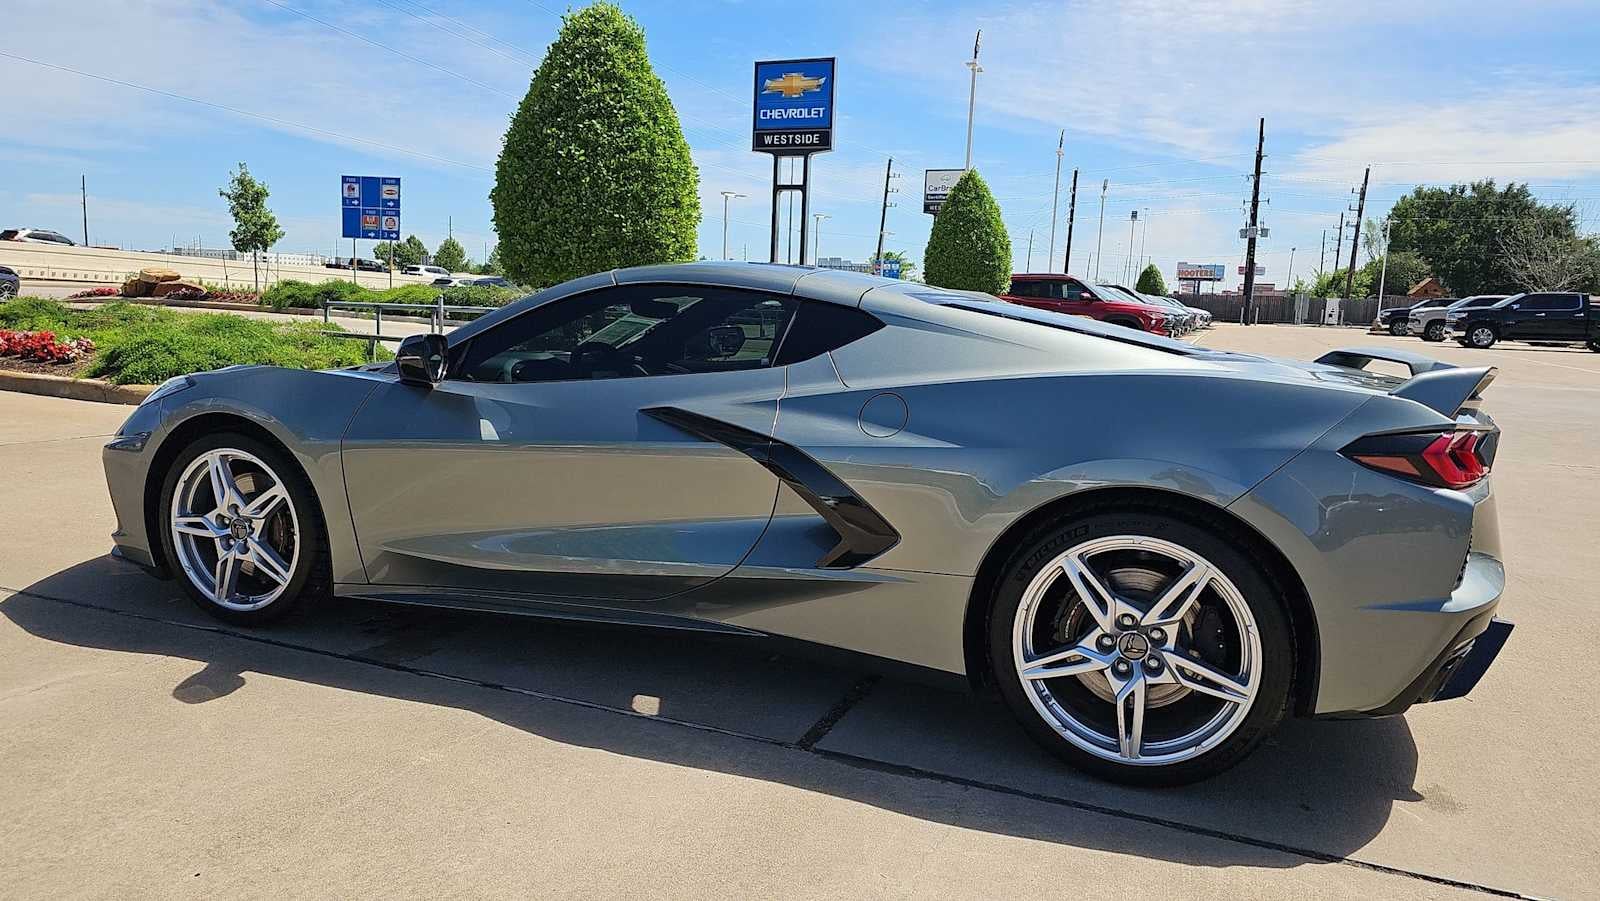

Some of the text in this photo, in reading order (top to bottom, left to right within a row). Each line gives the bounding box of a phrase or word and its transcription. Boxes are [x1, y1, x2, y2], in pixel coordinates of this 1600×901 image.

[760, 107, 825, 119] CHEVROLET
[764, 134, 820, 145] WESTSIDE
[1179, 269, 1215, 277] HOOTERS
